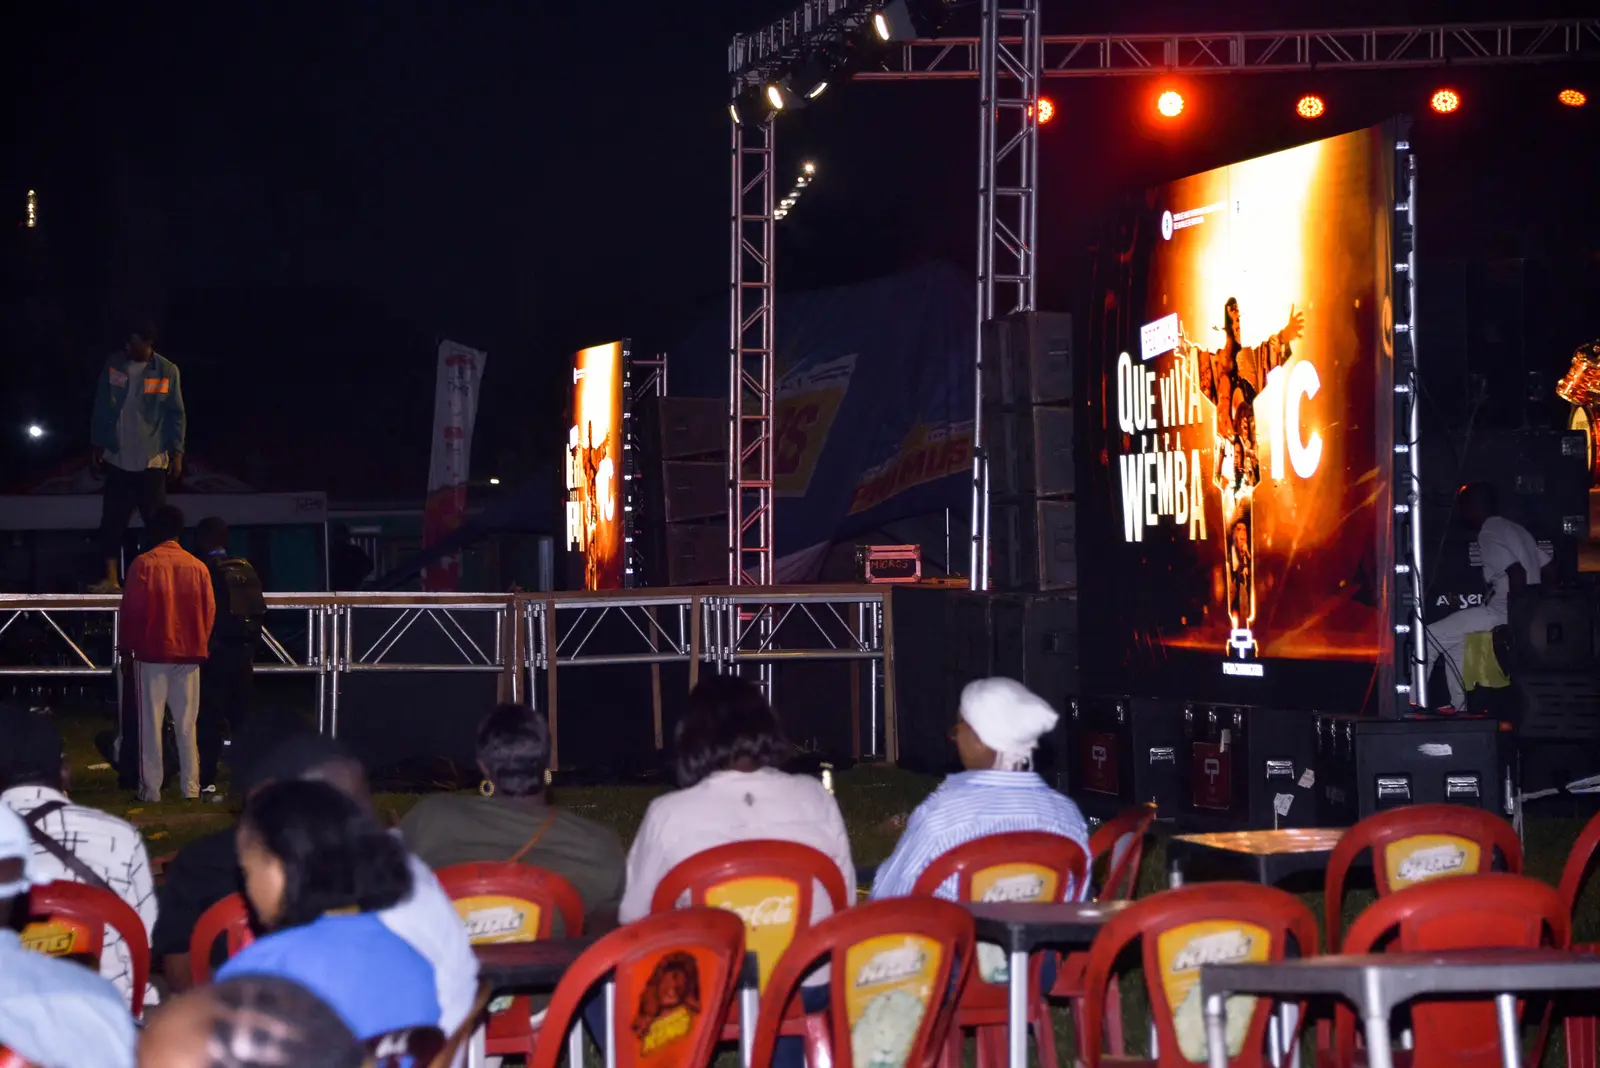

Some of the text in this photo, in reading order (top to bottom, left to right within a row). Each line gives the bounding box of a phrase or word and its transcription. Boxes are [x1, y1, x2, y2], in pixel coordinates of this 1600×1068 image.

[1118, 352, 1157, 435] QUE
[1141, 432, 1182, 454] PAPA
[1119, 449, 1207, 542] WEMBA
